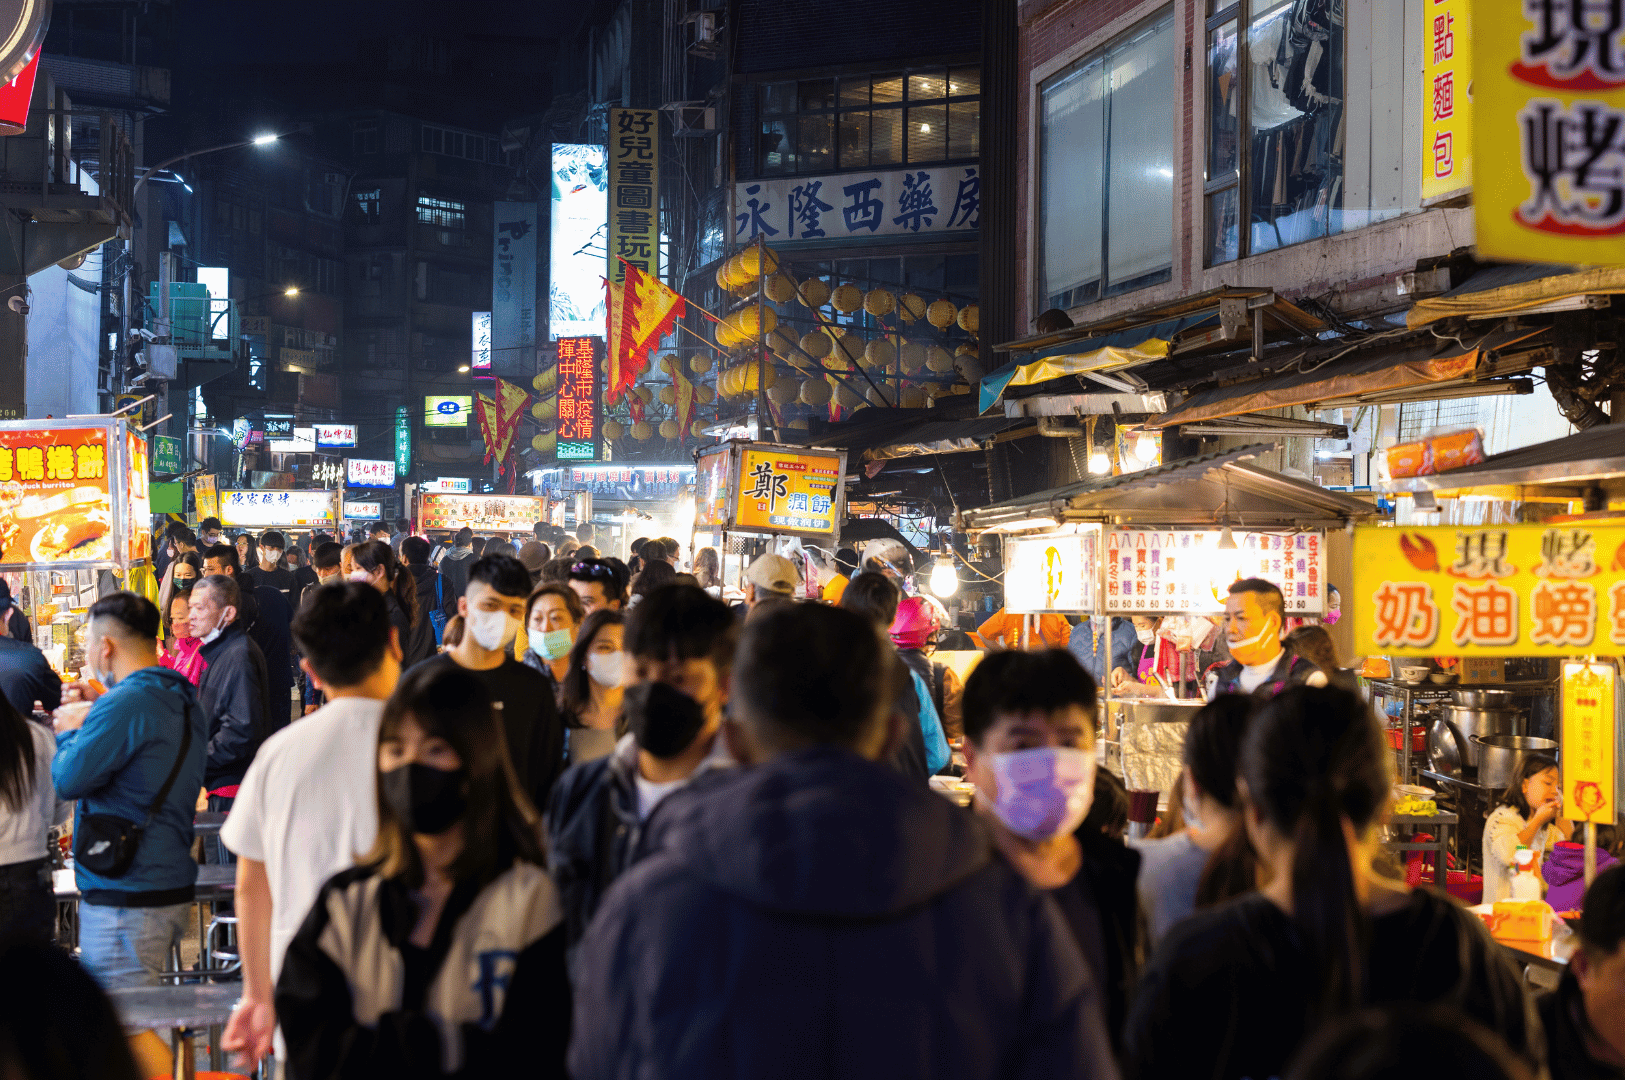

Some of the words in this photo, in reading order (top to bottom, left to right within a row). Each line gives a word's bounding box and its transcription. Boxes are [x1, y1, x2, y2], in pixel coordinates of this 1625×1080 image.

[1433, 0, 1454, 179] 點麵包
[736, 168, 979, 240] 永隆西藥房
[558, 338, 576, 438] 揮中心關心
[575, 338, 594, 439] 基隆市疫情
[22, 482, 41, 490] duck
[42, 481, 76, 489] burritos
[743, 461, 789, 513] 鄭
[788, 493, 832, 514] 潤餅
[1108, 533, 1119, 596] 八寶冬粉
[1136, 533, 1147, 596] 八寶米粉
[1455, 529, 1593, 575] 現烤
[1108, 599, 1119, 609] 60
[1122, 599, 1132, 609] 60
[1136, 599, 1146, 609] 60
[1150, 599, 1160, 609] 60
[1165, 599, 1175, 609] 50
[1296, 600, 1306, 609] 60
[1375, 584, 1625, 642] 奶油螃
